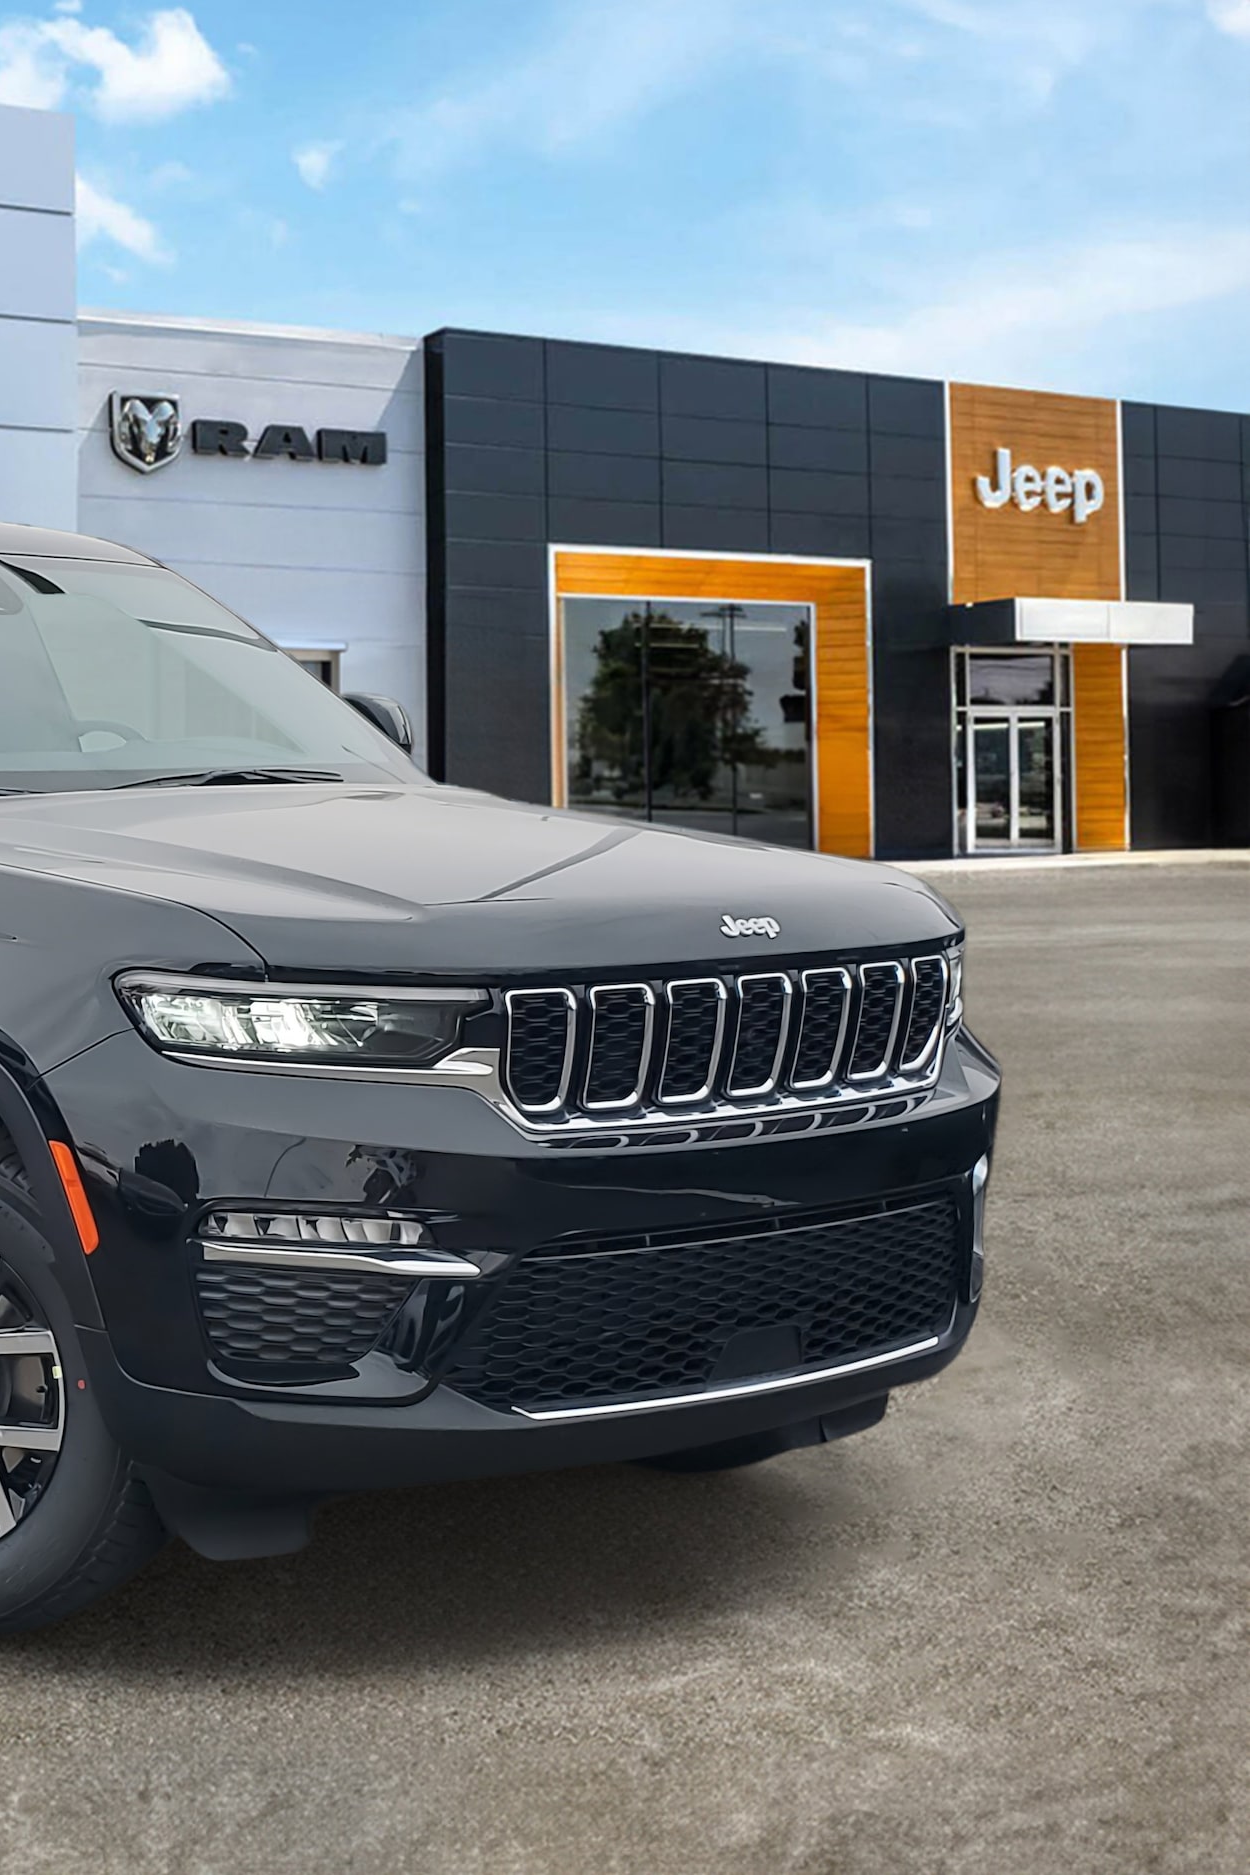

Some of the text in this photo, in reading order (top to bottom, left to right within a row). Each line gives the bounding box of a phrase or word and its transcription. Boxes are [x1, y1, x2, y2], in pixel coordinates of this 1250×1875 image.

[191, 418, 387, 466] RAM
[975, 447, 1104, 524] Jeep
[719, 914, 781, 939] Jeep
